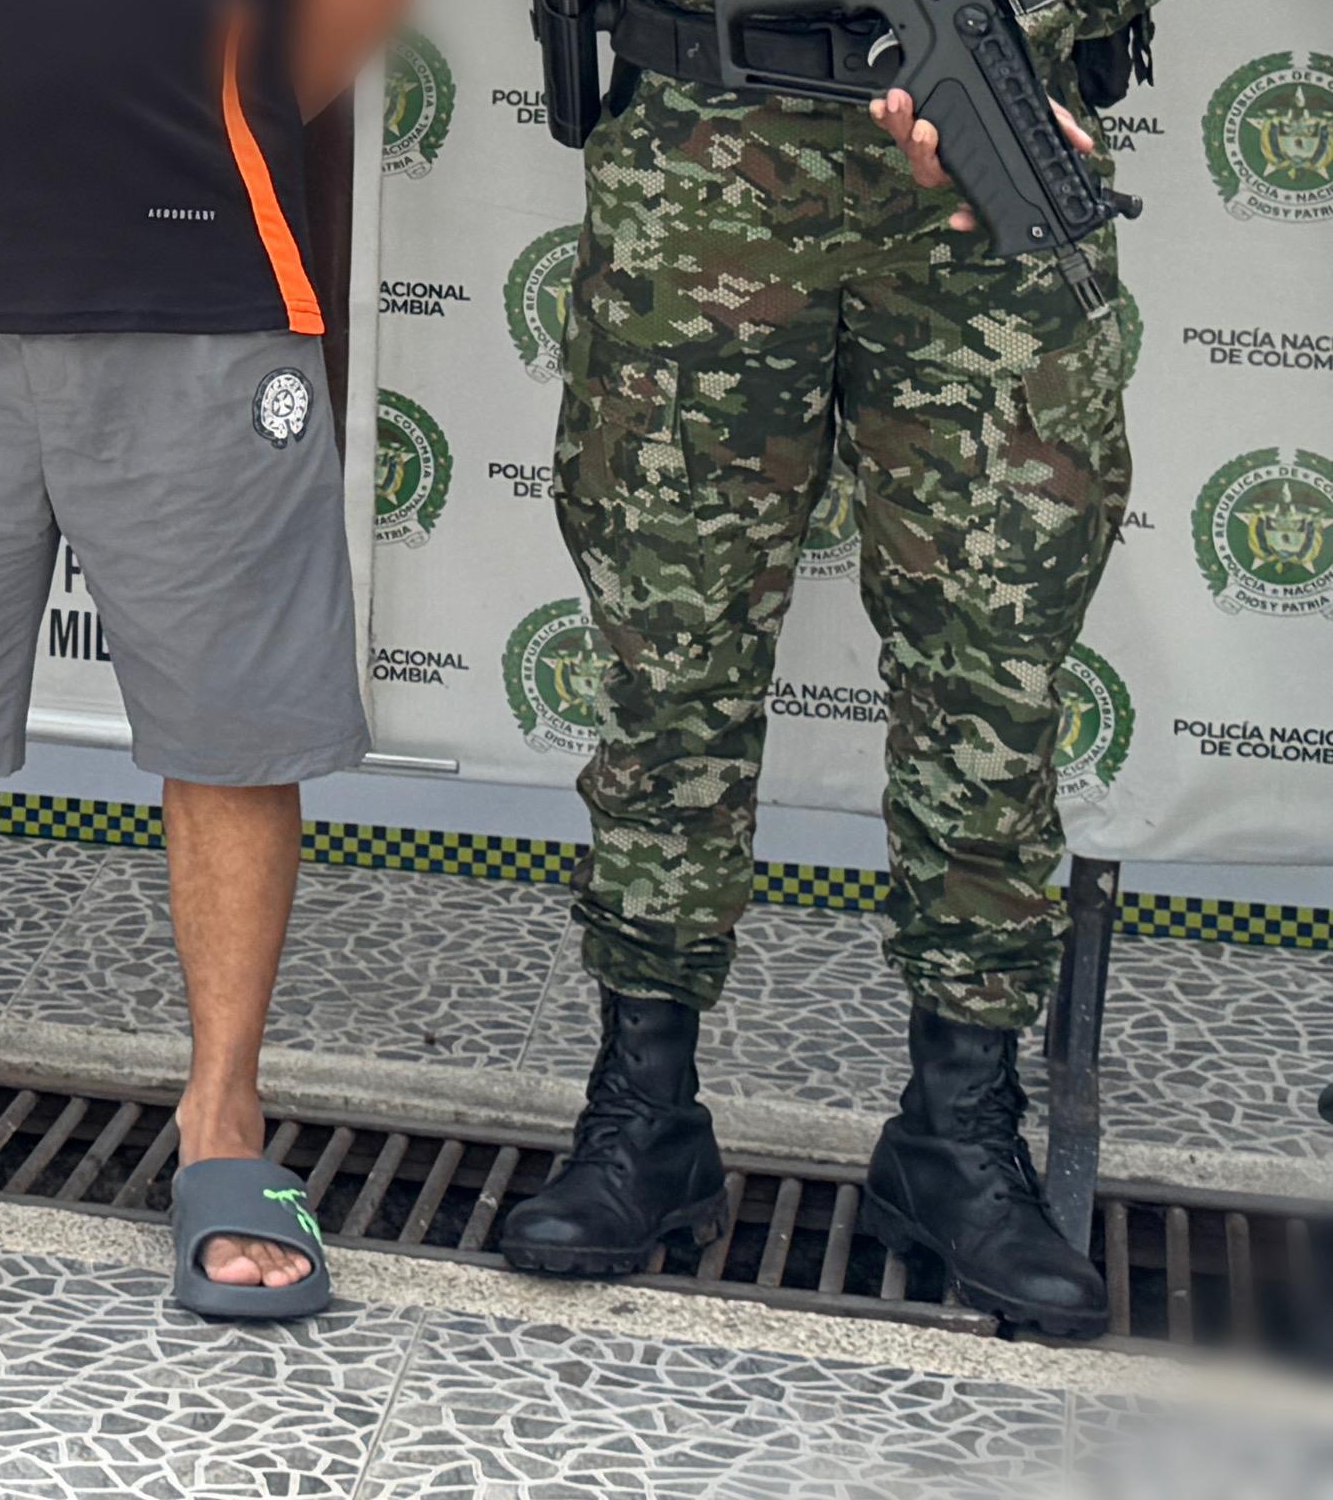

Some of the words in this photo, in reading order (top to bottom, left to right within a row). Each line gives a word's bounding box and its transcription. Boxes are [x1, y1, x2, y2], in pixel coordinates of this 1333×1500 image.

[1292, 71, 1311, 82] DE
[491, 89, 544, 108] POLI
[517, 108, 546, 125] DE
[1101, 117, 1164, 135] ONAL
[383, 123, 428, 156] ACIONAL
[380, 281, 471, 302] ACIONAL
[379, 298, 445, 317] OMBIA
[1183, 328, 1276, 350] POLICÍA
[1281, 334, 1333, 352] NACI
[1210, 348, 1244, 365] DE
[1247, 350, 1333, 371] COLOM
[394, 414, 432, 479] COLOMBIA
[488, 462, 552, 482] POLIC
[1279, 467, 1299, 477] DE
[513, 481, 544, 498] DE
[376, 526, 411, 541] ATRIA
[810, 560, 856, 576] PATRIA
[1282, 595, 1330, 613] PATRIA
[376, 649, 469, 670] ACIONAL
[373, 665, 444, 685] OMBIA
[801, 683, 889, 705] NACION
[1070, 662, 1112, 730] COLOMBIA
[771, 700, 889, 722] COLOMBIA
[1173, 719, 1265, 743] POLICÍA
[1059, 744, 1106, 778] CIONAL
[1201, 739, 1232, 757] DE
[1237, 742, 1333, 765] COLOMB
